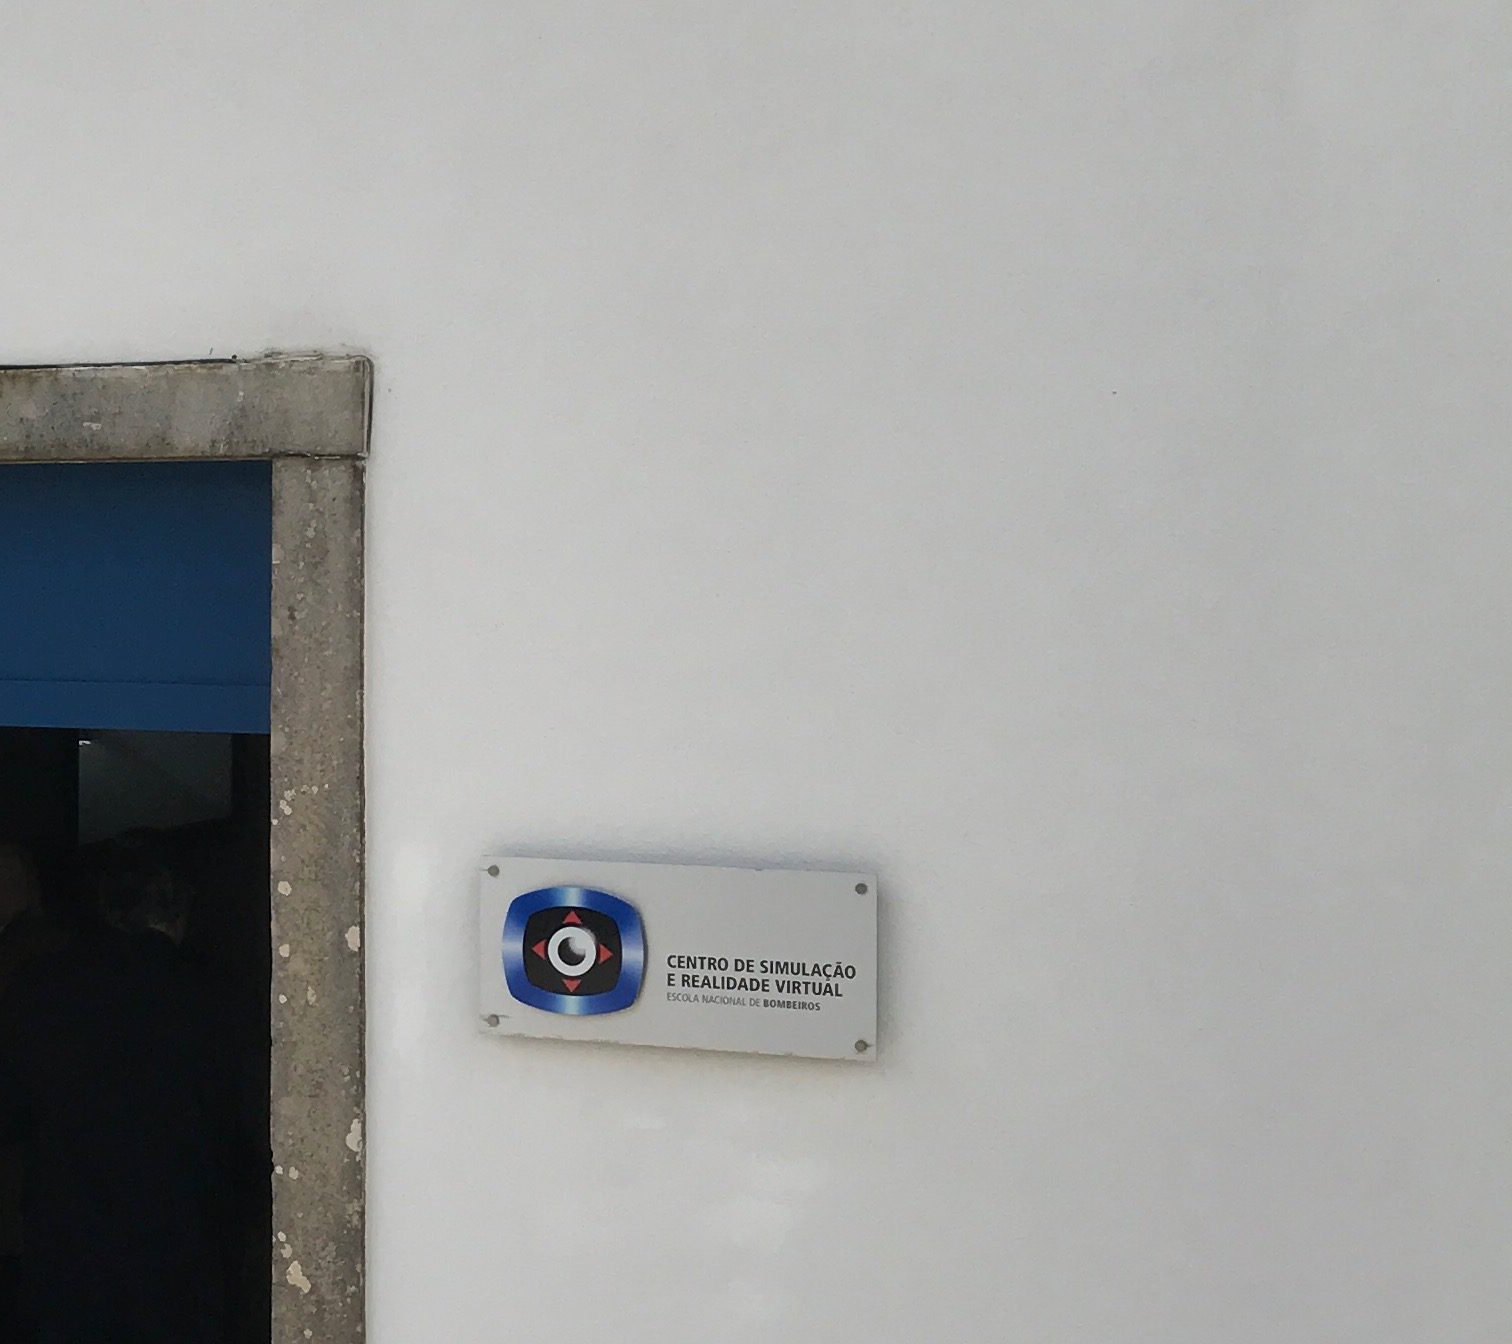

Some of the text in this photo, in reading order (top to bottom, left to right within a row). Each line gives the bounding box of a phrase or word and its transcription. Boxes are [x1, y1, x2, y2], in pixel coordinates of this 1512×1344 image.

[667, 955, 857, 982] CENTRO DE SIMULAÇÃO
[667, 973, 843, 997] E REALIDADE VIRTUAL
[666, 992, 821, 1011] ESCOLA NACIONAL DE BOMBEIROS
